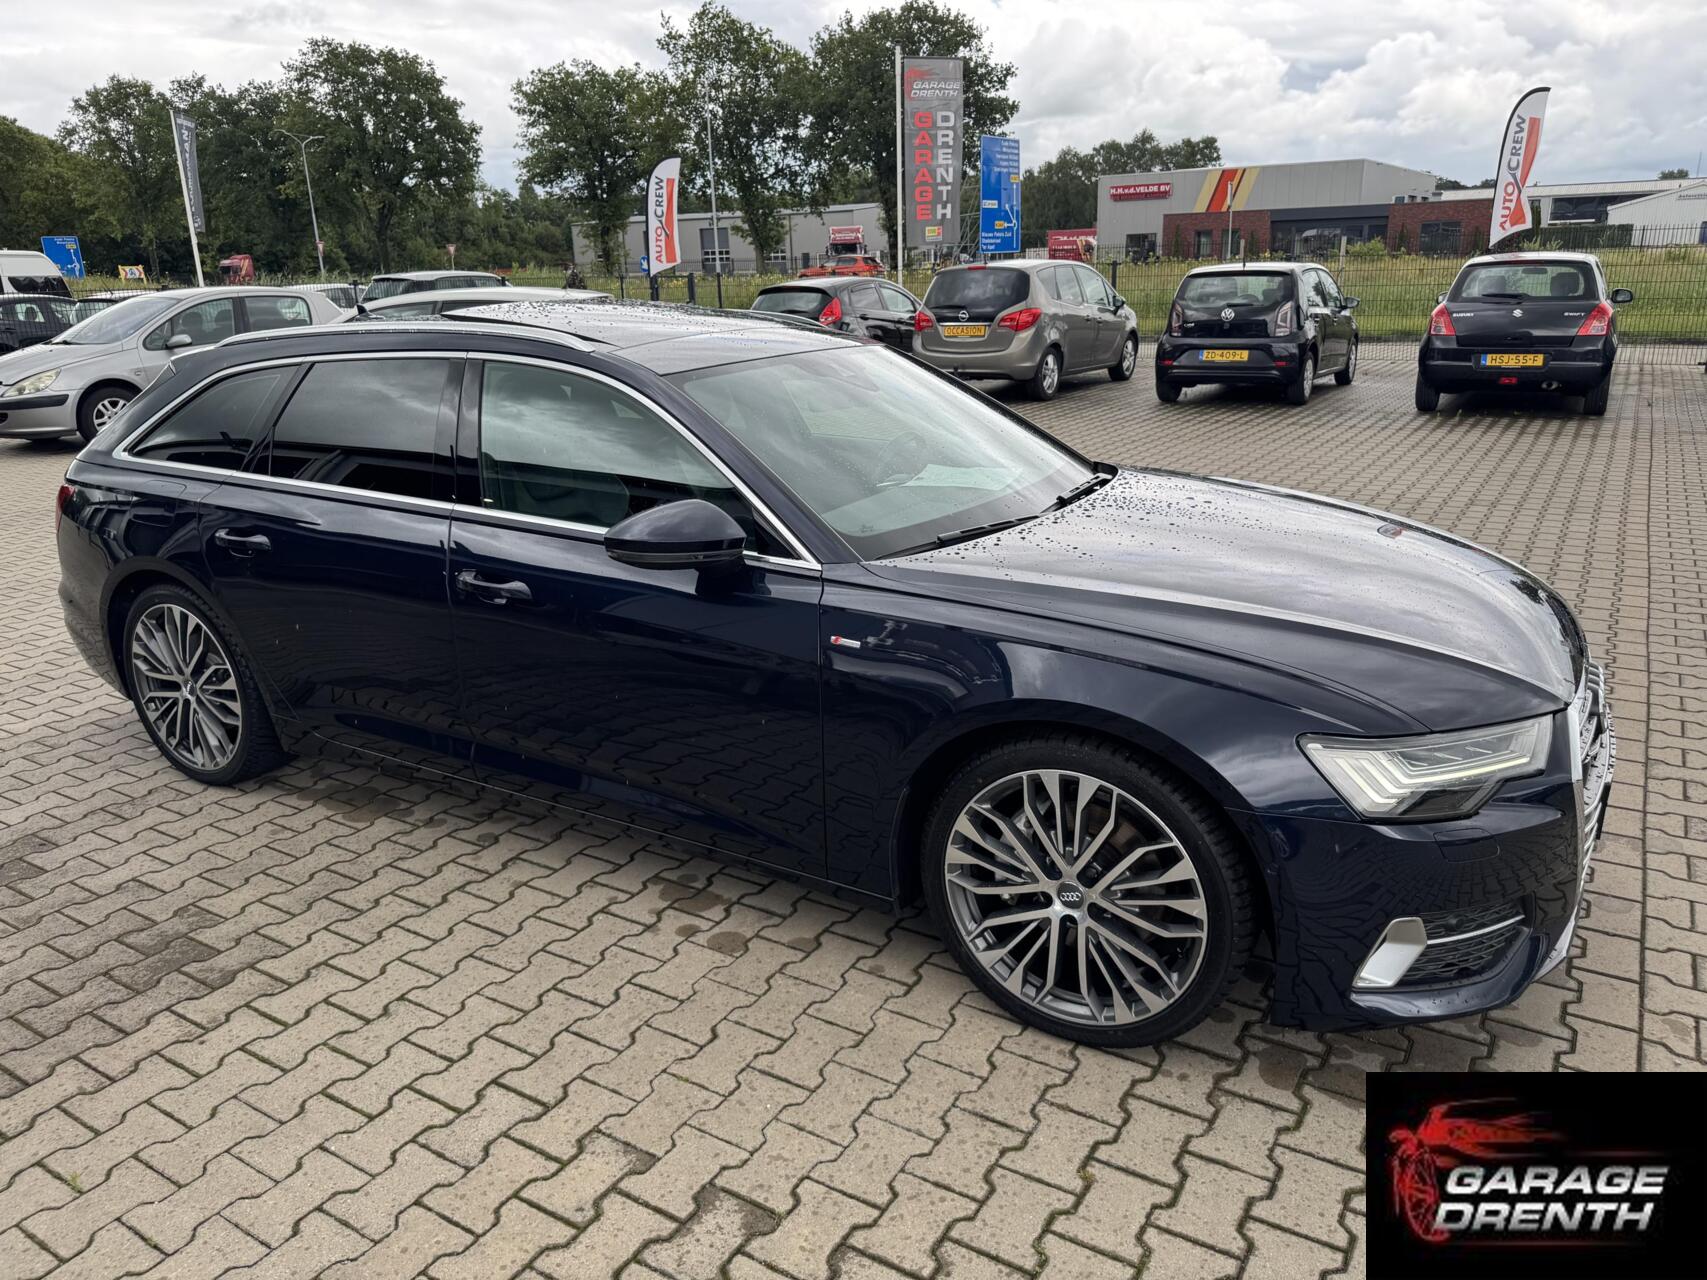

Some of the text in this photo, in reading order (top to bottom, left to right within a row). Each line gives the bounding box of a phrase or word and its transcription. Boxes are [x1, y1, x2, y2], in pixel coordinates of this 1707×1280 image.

[913, 80, 961, 90] GARAGE
[910, 90, 958, 98] DRENTH
[914, 111, 934, 221] GARAGE
[936, 111, 955, 220] DRENTH
[946, 326, 982, 335] OCCASION
[1205, 351, 1245, 360] ZD-409-L
[1490, 355, 1539, 364] HSJ-55-F
